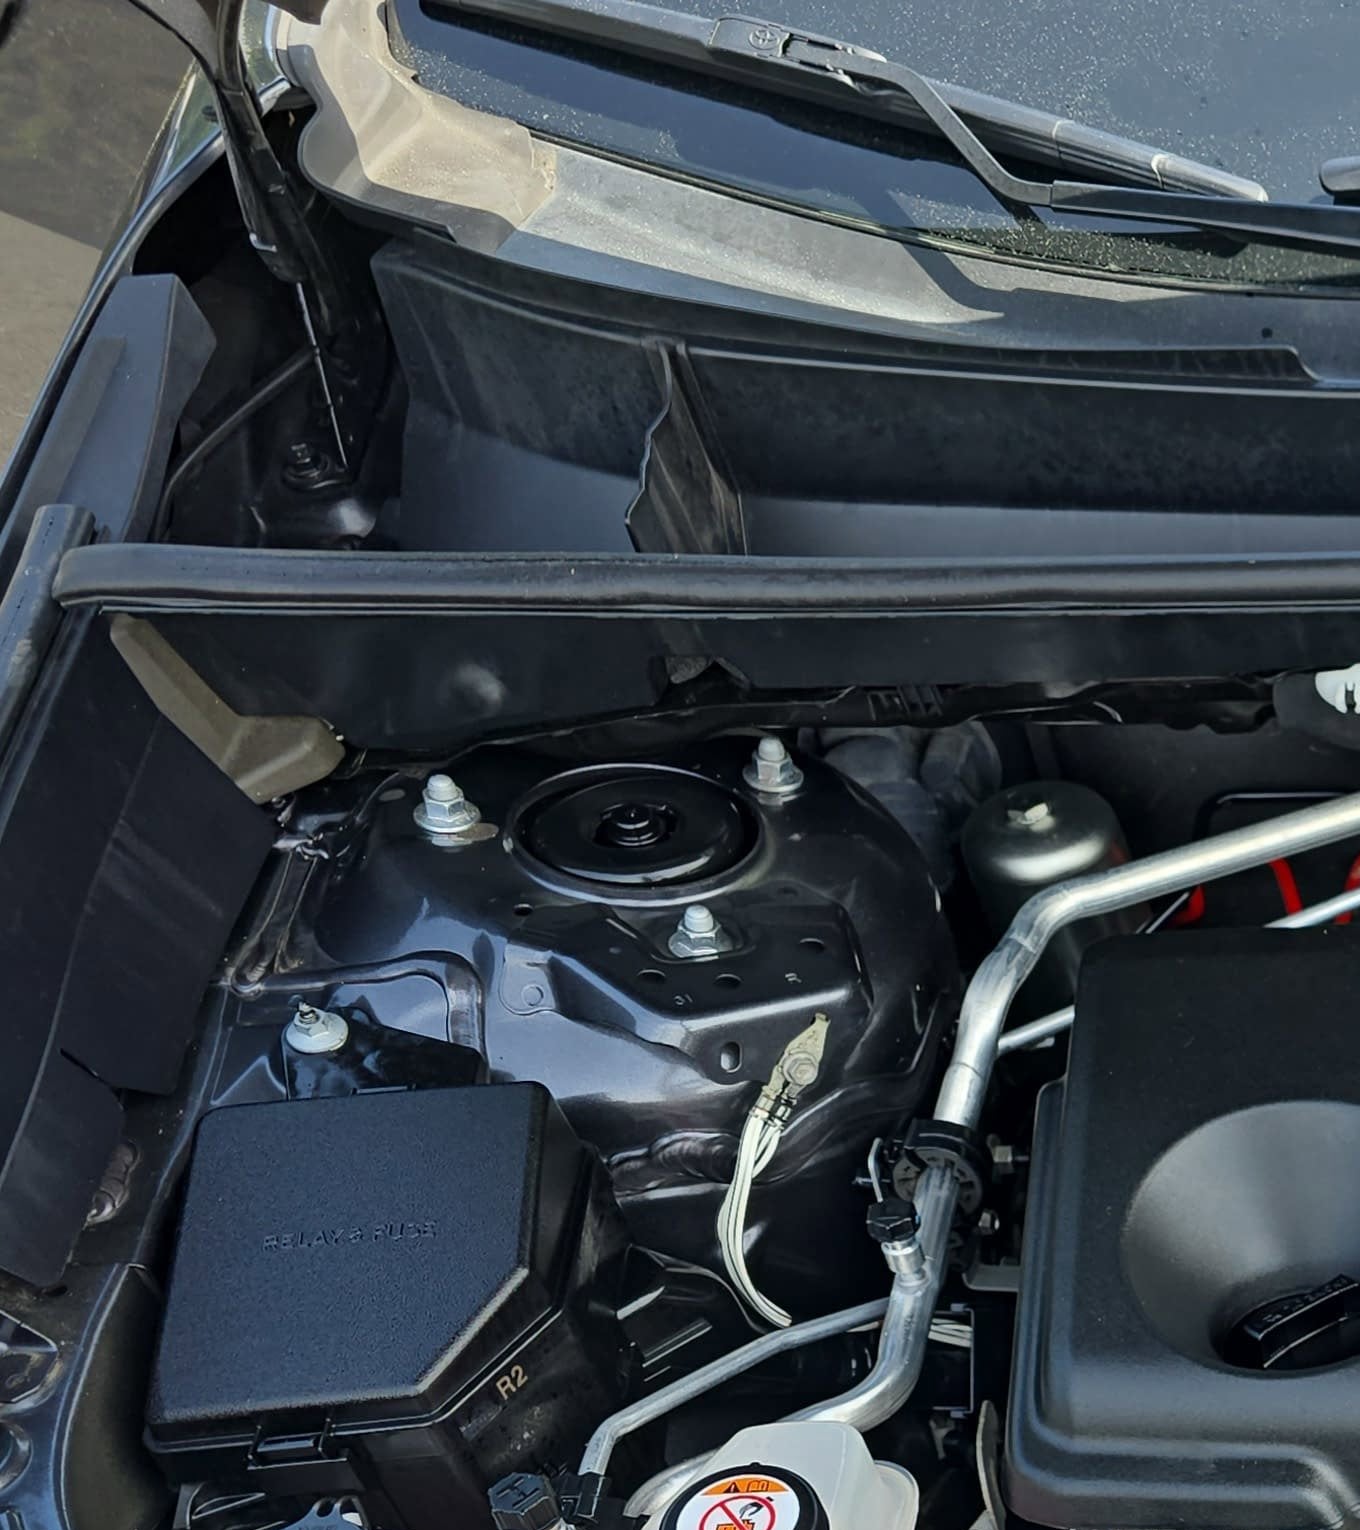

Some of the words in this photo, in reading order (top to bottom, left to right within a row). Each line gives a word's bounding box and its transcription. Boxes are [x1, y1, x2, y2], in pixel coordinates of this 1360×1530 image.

[263, 1228, 345, 1251] RELAY
[373, 1219, 438, 1242] FUSE
[496, 1365, 528, 1400] R2
[496, 1477, 541, 1509] H
